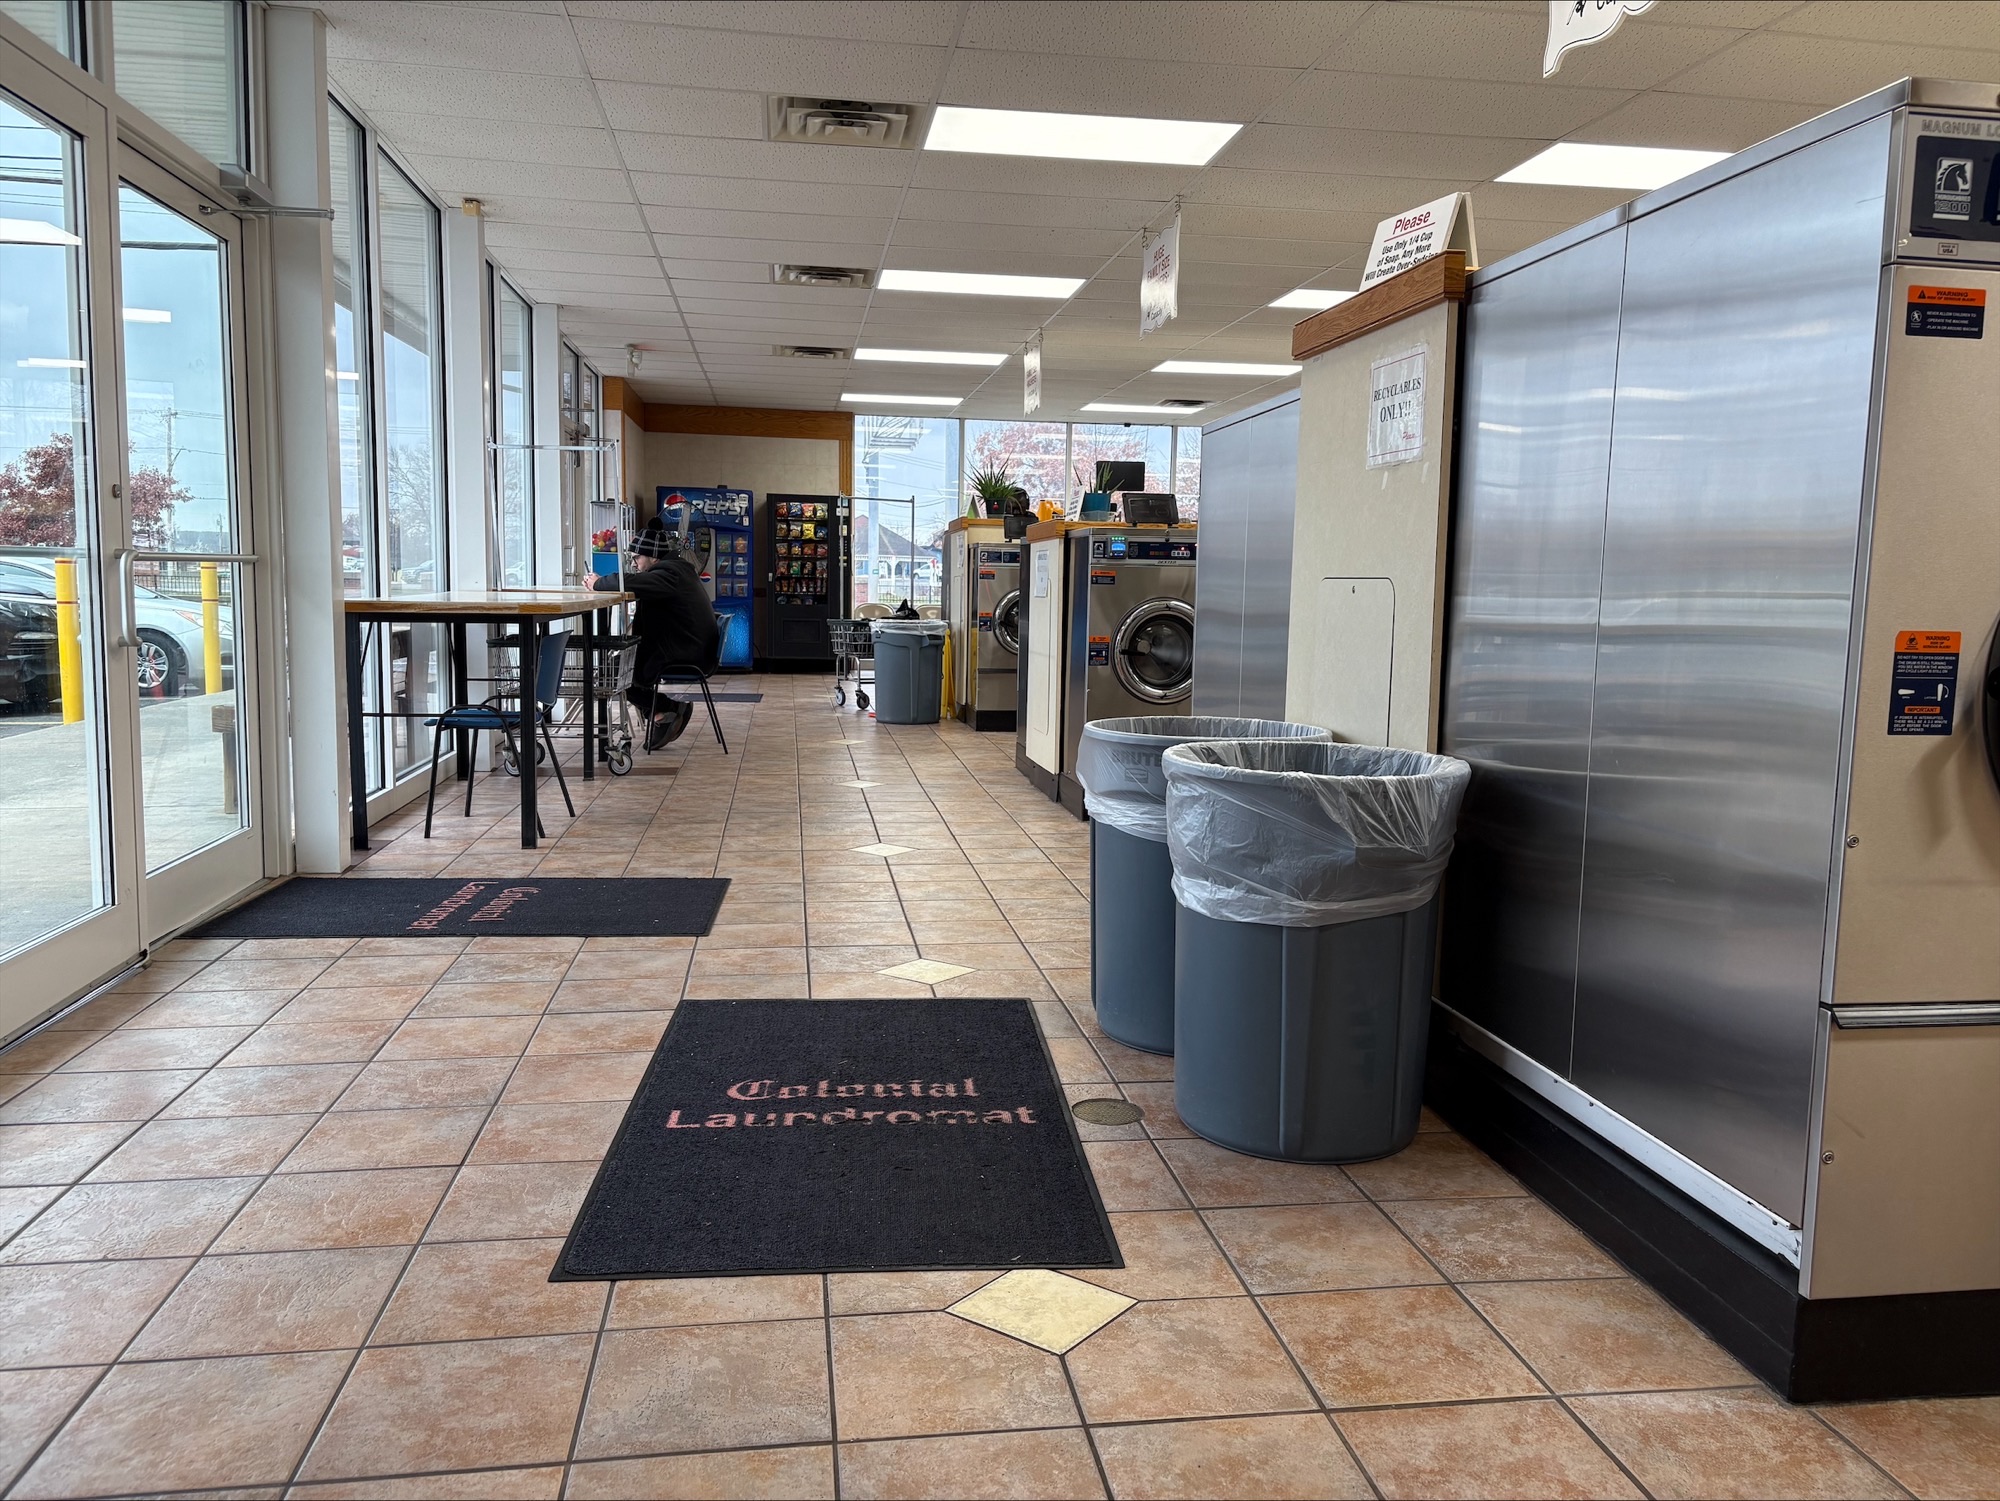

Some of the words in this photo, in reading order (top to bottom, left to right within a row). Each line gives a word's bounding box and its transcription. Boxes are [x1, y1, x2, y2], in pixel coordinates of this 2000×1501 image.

[1921, 120, 1981, 136] MAGNUM
[1934, 201, 1970, 213] 1200
[1393, 212, 1430, 234] Please
[1377, 257, 1384, 267] of
[1401, 249, 1414, 260] Any
[1415, 242, 1431, 255] More
[1382, 244, 1392, 255] Use
[1394, 240, 1407, 251] Only
[1409, 236, 1419, 246] 1/4
[1420, 231, 1433, 243] Cup
[1365, 271, 1375, 281] Will
[1376, 266, 1395, 278] Create
[1374, 378, 1421, 401] RECYCLABLES
[1380, 401, 1411, 423] ONLY!!
[406, 882, 498, 930] Laundromat
[468, 886, 541, 921] Colonial
[726, 1077, 980, 1101] Colonial
[666, 1105, 1036, 1129] Laundromat
